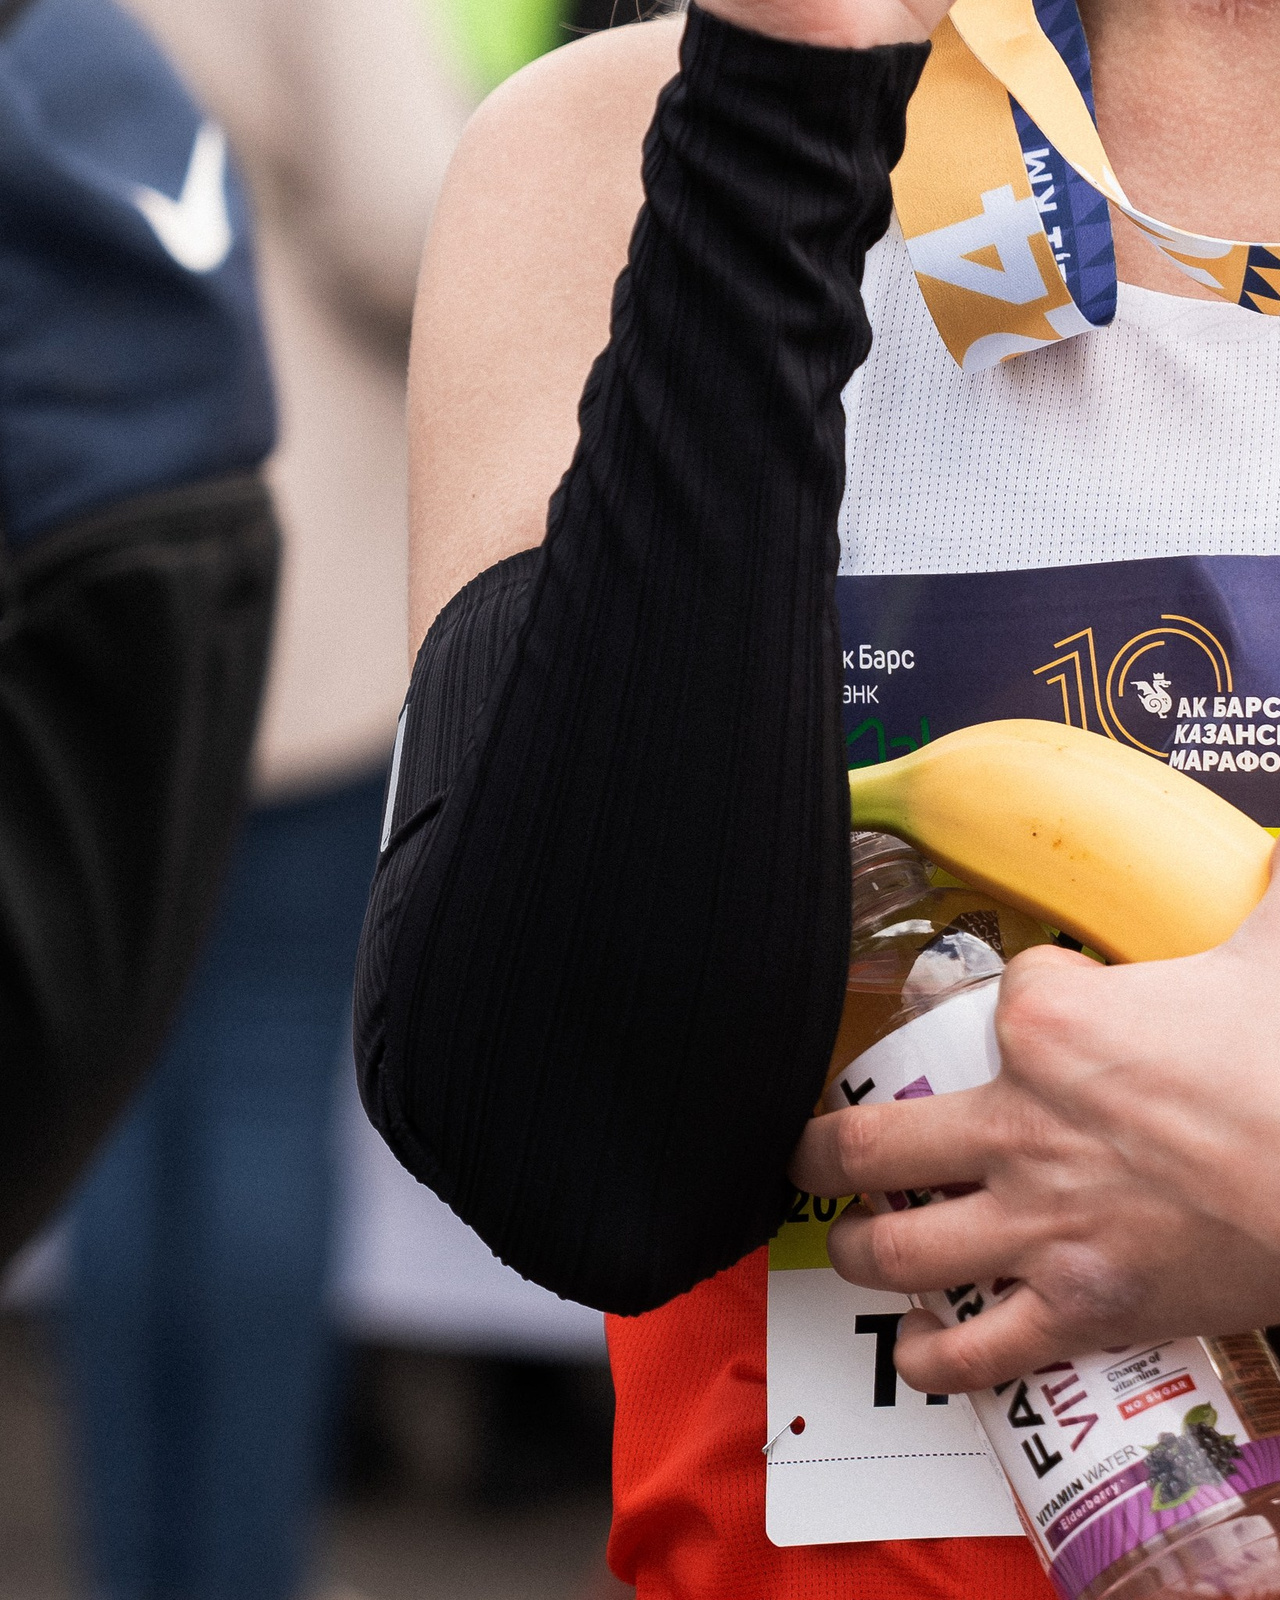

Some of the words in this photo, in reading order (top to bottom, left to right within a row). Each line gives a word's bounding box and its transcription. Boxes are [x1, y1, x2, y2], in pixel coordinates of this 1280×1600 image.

[859, 644, 915, 675] Барс
[1176, 697, 1207, 719] АК
[1107, 1359, 1148, 1382] Charge
[1148, 1351, 1161, 1364] of
[1112, 1366, 1160, 1393] vitamins
[1124, 1400, 1142, 1413] NO
[1145, 1380, 1188, 1403] SUGAR
[1035, 1478, 1084, 1527] VITAMIN
[1083, 1445, 1138, 1484] WATER
[1059, 1482, 1120, 1530] Elderberry
